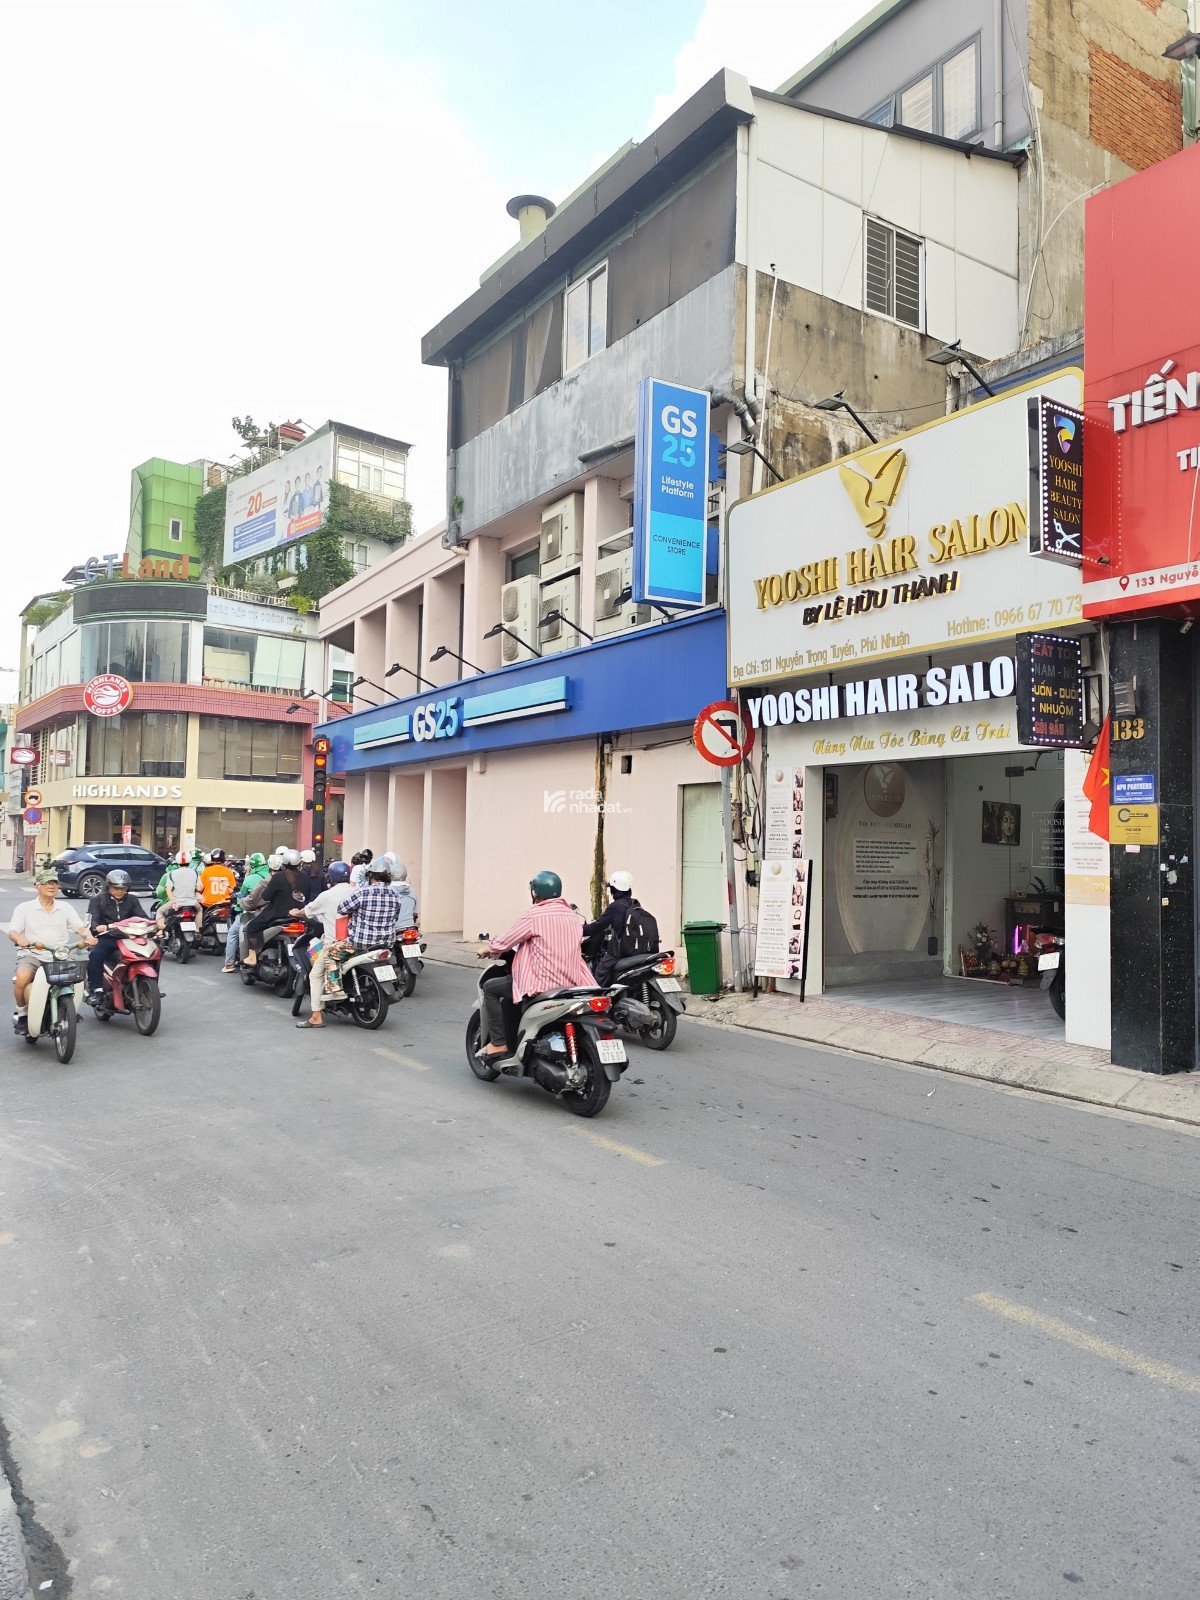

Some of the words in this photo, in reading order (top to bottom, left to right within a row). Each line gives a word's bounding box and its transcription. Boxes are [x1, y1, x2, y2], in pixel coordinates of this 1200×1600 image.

[661, 405, 697, 438] GS
[661, 434, 696, 468] 25
[1176, 444, 1200, 471] TI
[1049, 454, 1083, 477] YOOSHI
[661, 475, 694, 490] Lifestyle
[661, 484, 694, 499] Platform
[1055, 474, 1077, 492] HAIR
[247, 491, 263, 518] 20
[1050, 490, 1083, 510] BEAUTY
[1053, 507, 1081, 525] SALON
[652, 534, 701, 549] CONVENIENCE
[667, 545, 686, 556] STORE
[121, 553, 190, 580] Land
[753, 556, 839, 610] YOOSHI
[845, 534, 918, 586] HAIR
[927, 502, 1028, 564] SALON
[1134, 576, 1156, 588] 133
[802, 604, 824, 626] BY
[824, 594, 845, 621] LÊ
[891, 569, 960, 605] THÀNH
[947, 616, 990, 637] Hotline:
[994, 606, 1024, 627] 0966
[1027, 602, 1043, 621] 67
[1047, 598, 1062, 618] 70
[1066, 593, 1083, 613] 73
[760, 657, 772, 672] 131
[805, 650, 828, 667] Trọng
[860, 635, 878, 653] Phú
[881, 631, 910, 651] Nhuận
[1034, 663, 1056, 678] NAM
[86, 674, 128, 695] HIGHLANDS
[747, 685, 840, 729] YOOSHI
[845, 673, 919, 717] HAIR
[925, 655, 1018, 707] SALO
[1033, 679, 1053, 697] UỐN
[90, 703, 124, 715] COFFEE
[412, 696, 462, 743] GS25
[1039, 701, 1074, 718] NHUỘM
[1112, 718, 1145, 741] 133
[72, 784, 183, 798] HIGHLANDS
